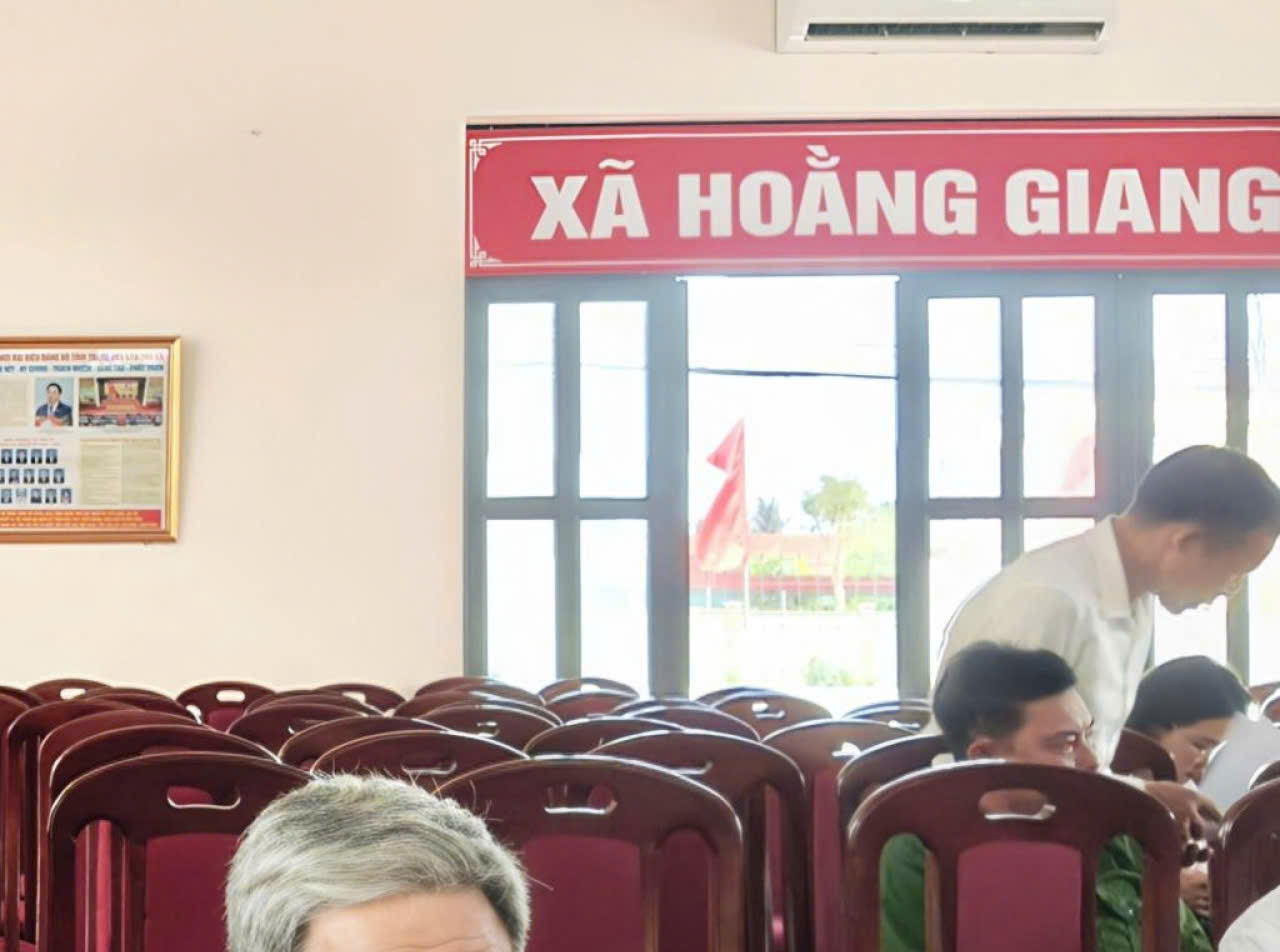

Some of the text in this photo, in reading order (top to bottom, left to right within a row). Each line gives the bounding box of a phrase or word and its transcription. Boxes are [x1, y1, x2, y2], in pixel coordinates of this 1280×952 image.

[531, 144, 1280, 240] XÃ HOẰNG GIANG
